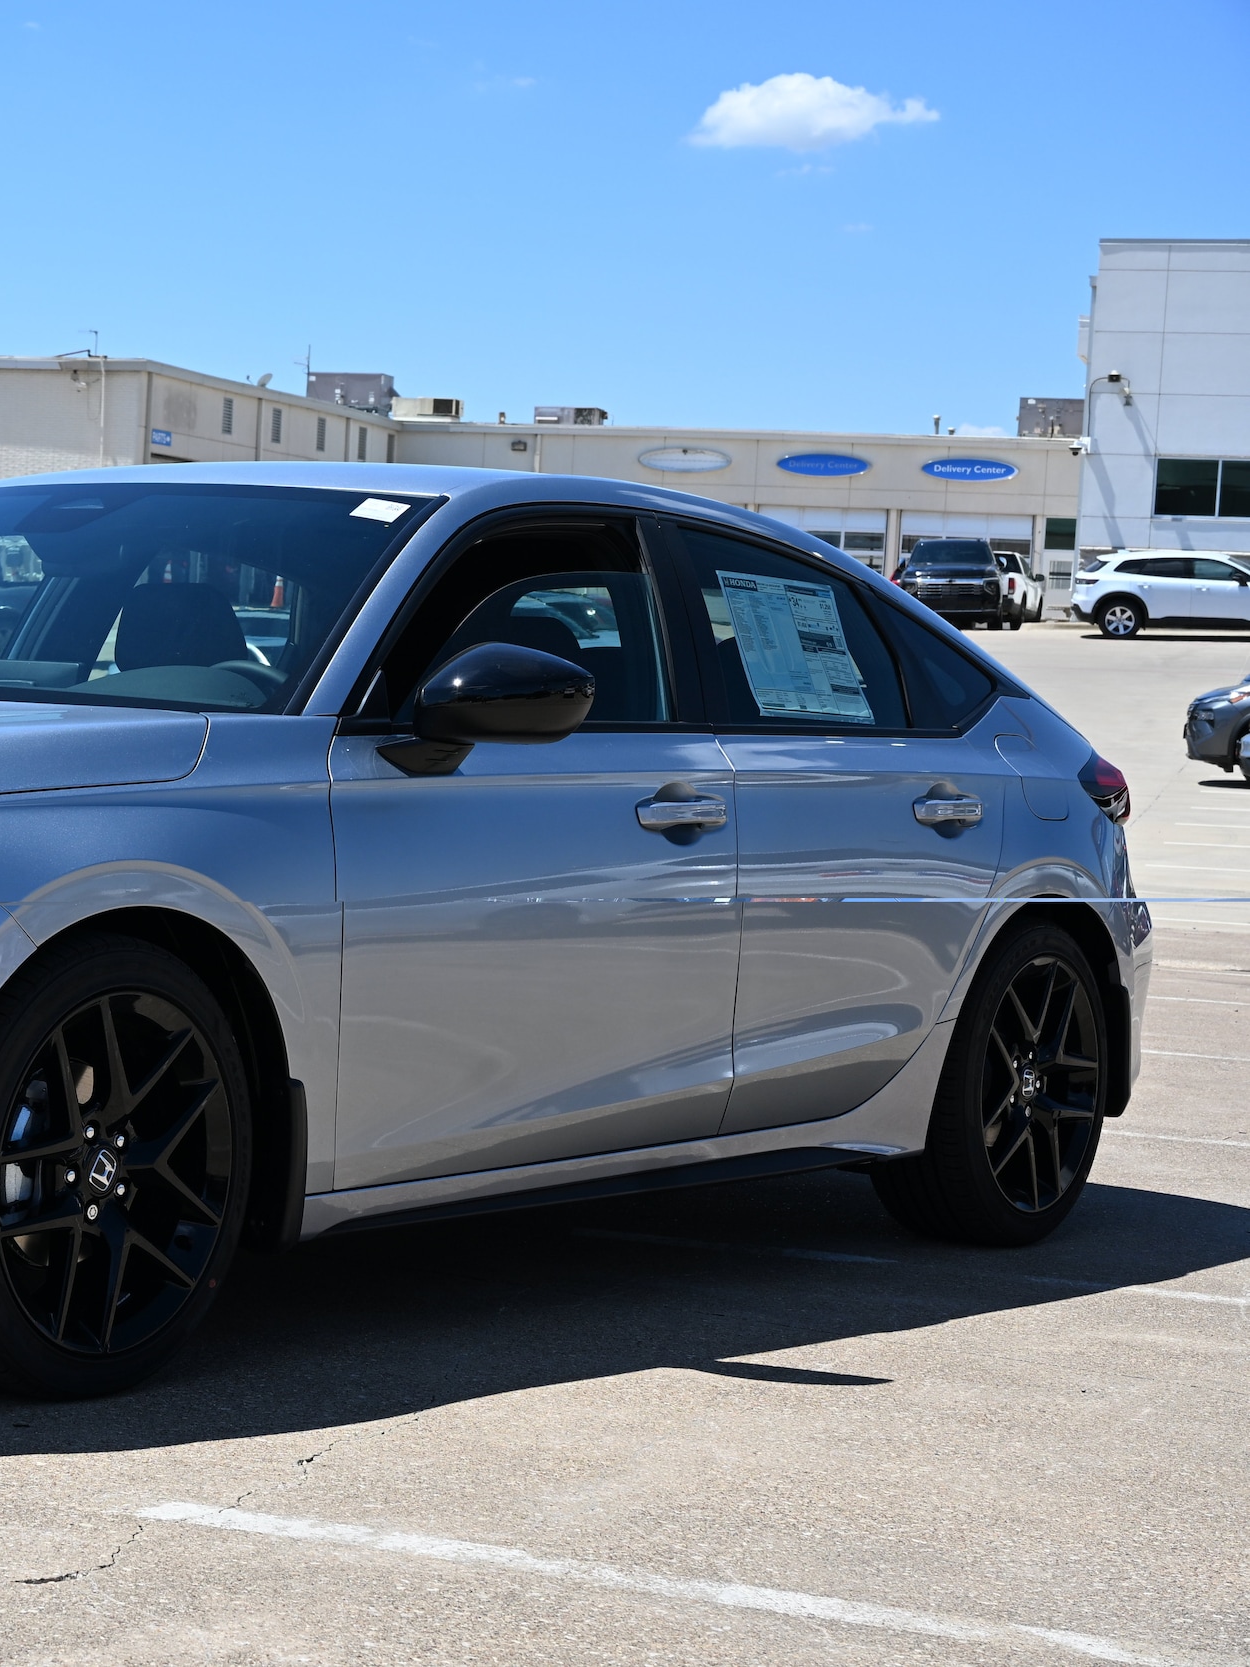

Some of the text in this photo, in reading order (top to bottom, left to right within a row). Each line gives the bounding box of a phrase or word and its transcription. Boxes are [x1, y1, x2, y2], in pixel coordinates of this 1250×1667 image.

[788, 460, 859, 470] Delivery Center
[933, 464, 1007, 475] Delivery Center
[729, 578, 757, 589] HONDA
